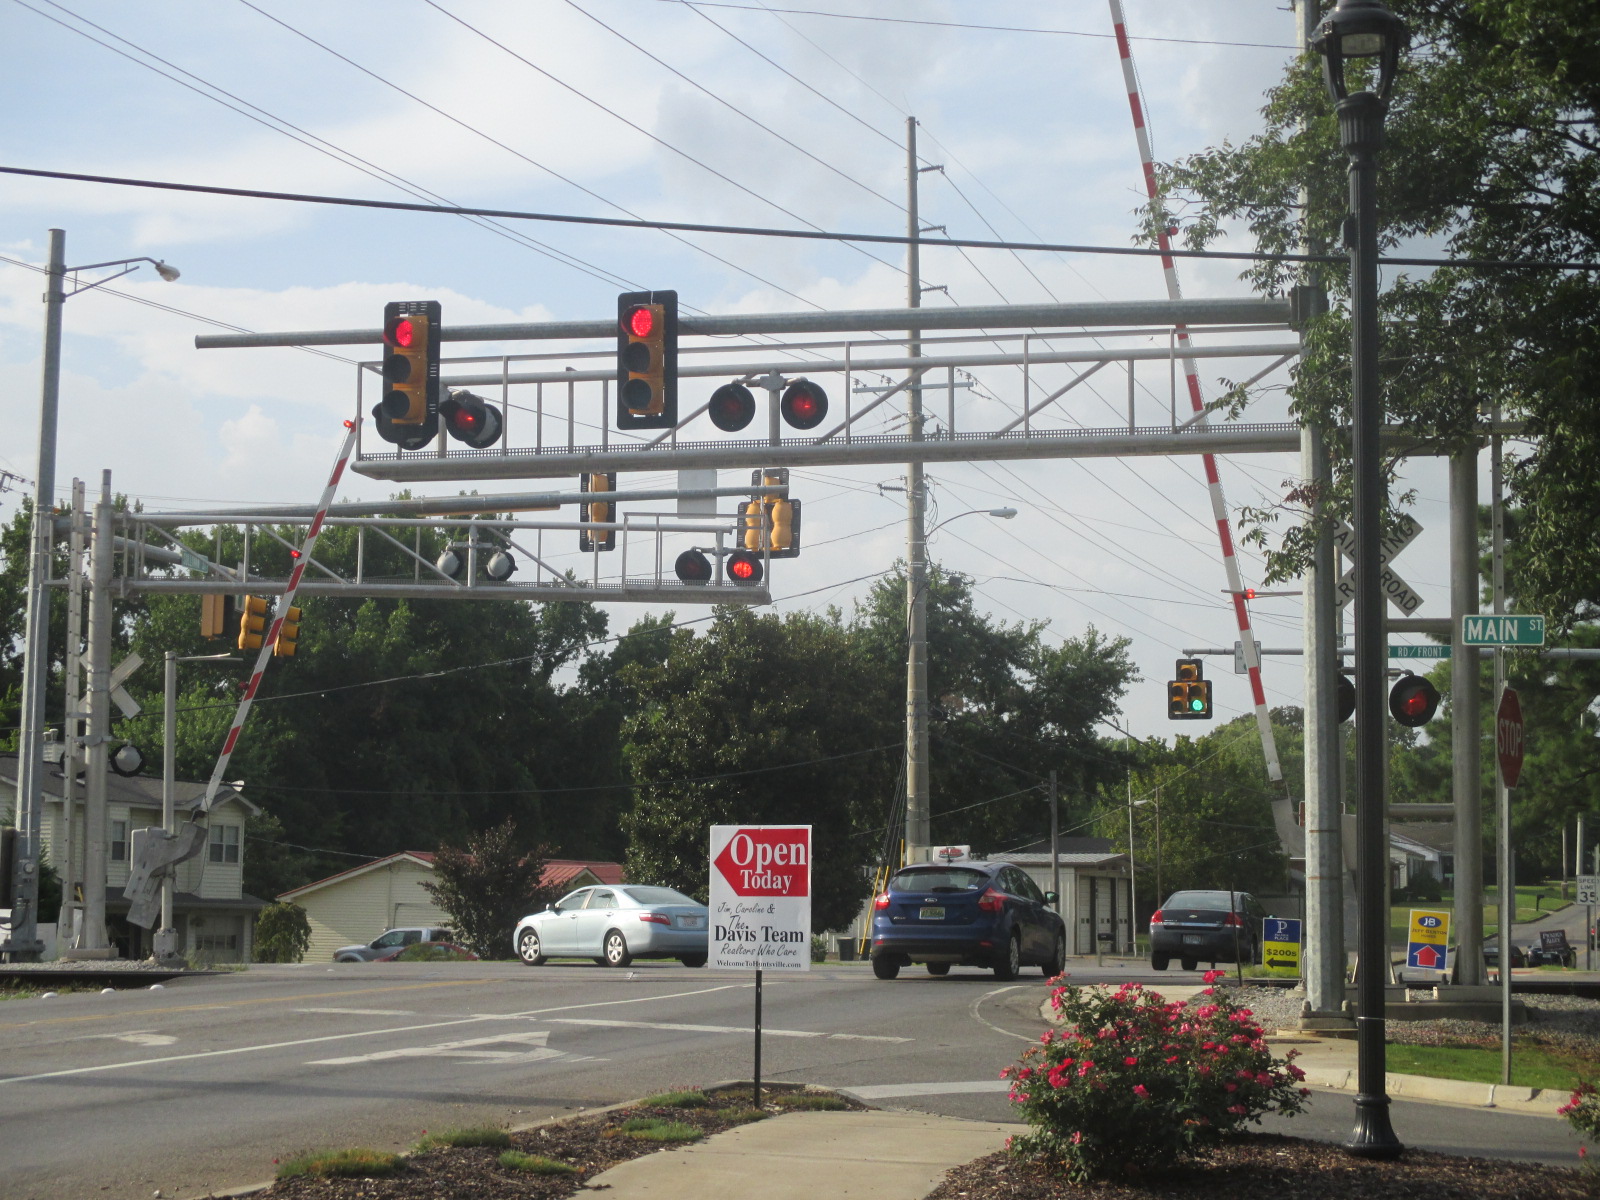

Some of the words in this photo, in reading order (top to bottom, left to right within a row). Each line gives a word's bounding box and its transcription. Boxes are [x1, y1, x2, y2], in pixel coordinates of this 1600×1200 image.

[1380, 570, 1418, 610] ROAD
[1467, 619, 1518, 641] MAIN
[1499, 717, 1522, 757] STOP
[730, 833, 807, 874] Open
[740, 869, 792, 895] Today
[1580, 891, 1599, 903] 35
[735, 902, 765, 914] Caroline
[766, 903, 776, 914] &
[728, 914, 745, 931] The
[1276, 920, 1288, 934] P
[715, 925, 757, 942] Davis
[760, 925, 804, 943] Team
[720, 942, 756, 956] Realtors
[757, 943, 775, 956] Who
[776, 944, 798, 957] Care
